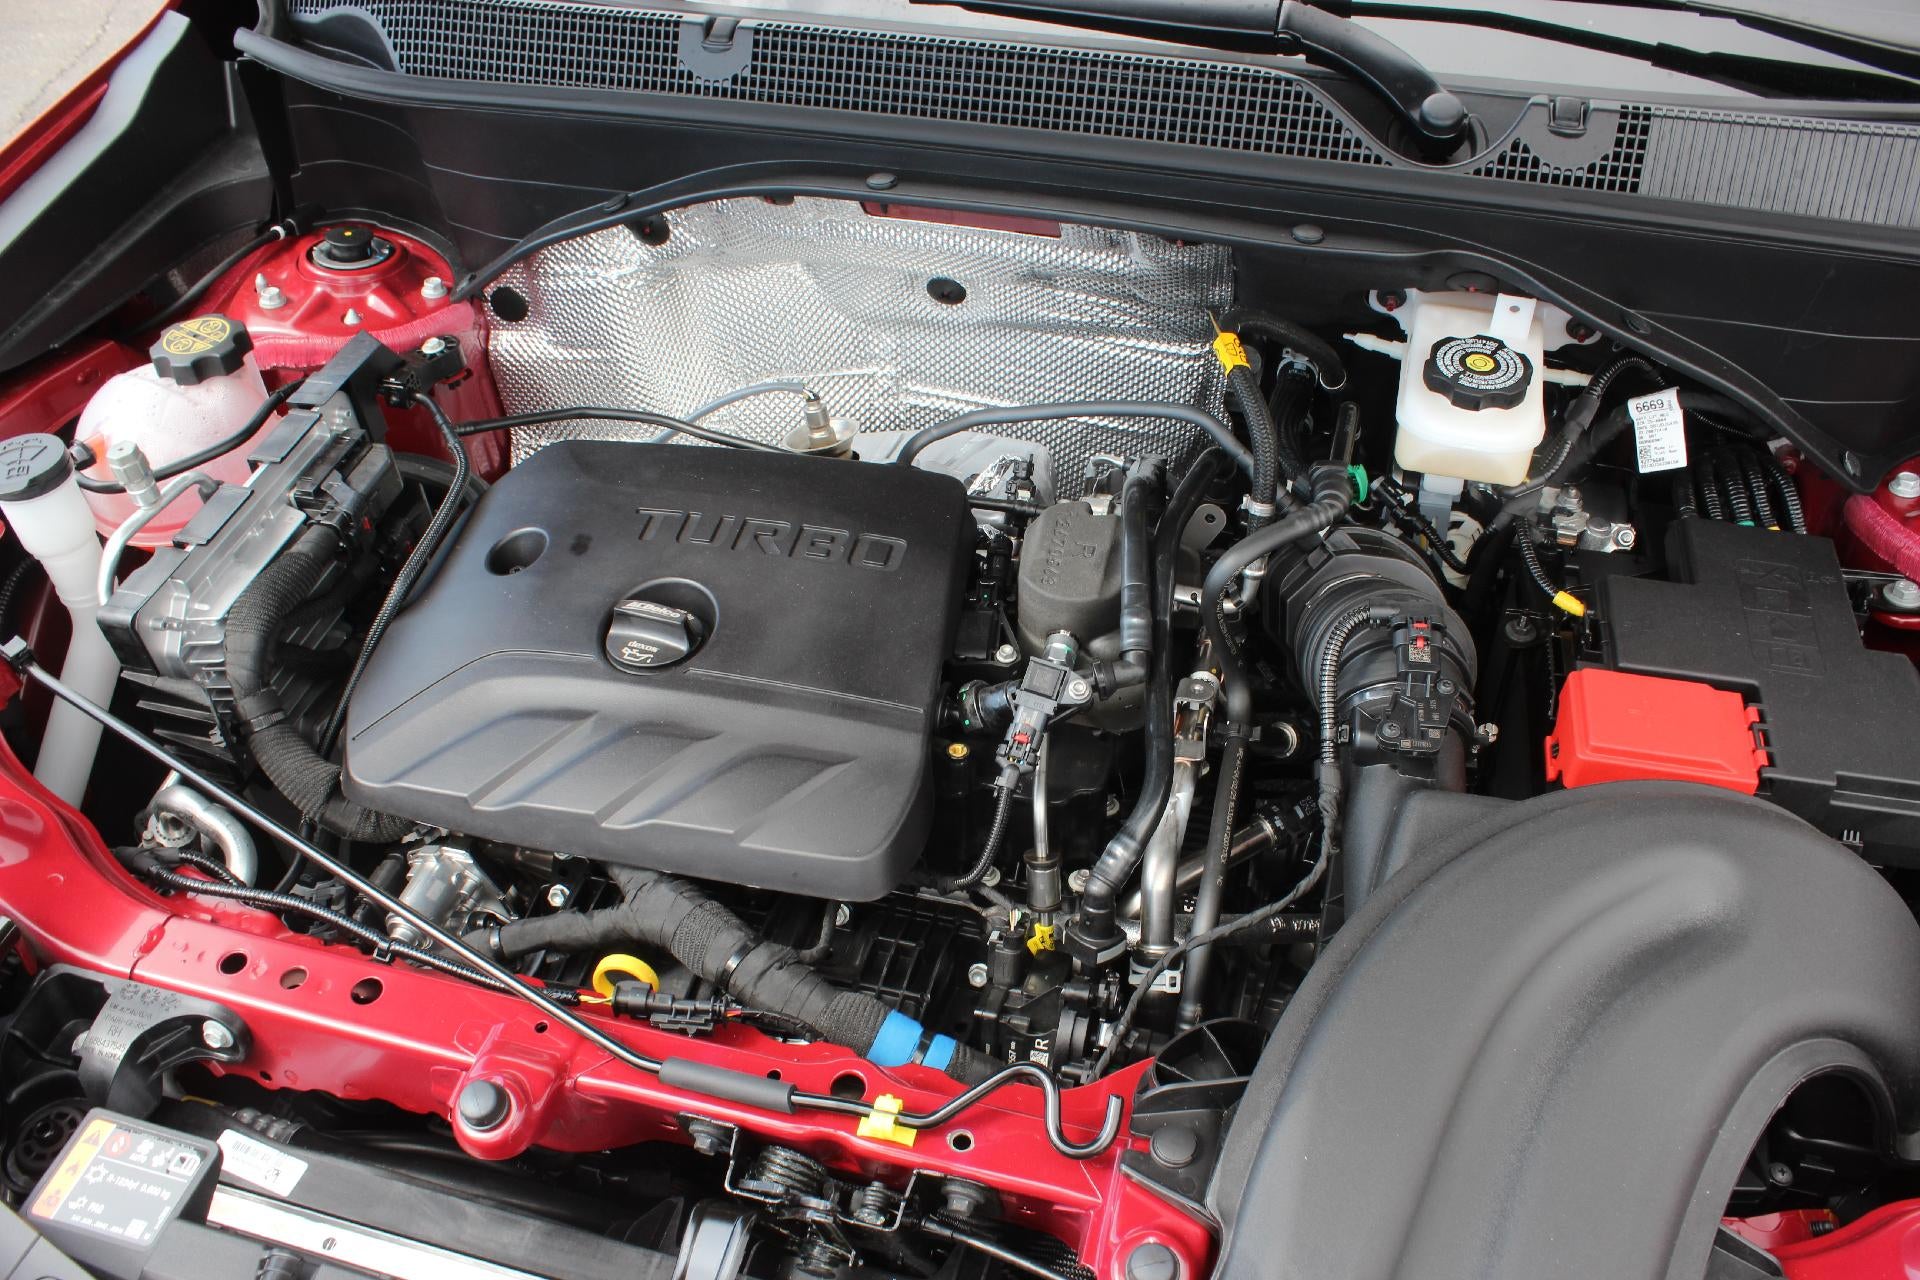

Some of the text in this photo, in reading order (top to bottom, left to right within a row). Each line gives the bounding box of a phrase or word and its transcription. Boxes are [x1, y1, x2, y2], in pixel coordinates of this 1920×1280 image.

[1635, 398, 1665, 413] 6669
[635, 506, 908, 572] TURBO
[624, 600, 681, 619] ACDelco
[627, 639, 661, 653] dexos
[1035, 1038, 1049, 1050] R
